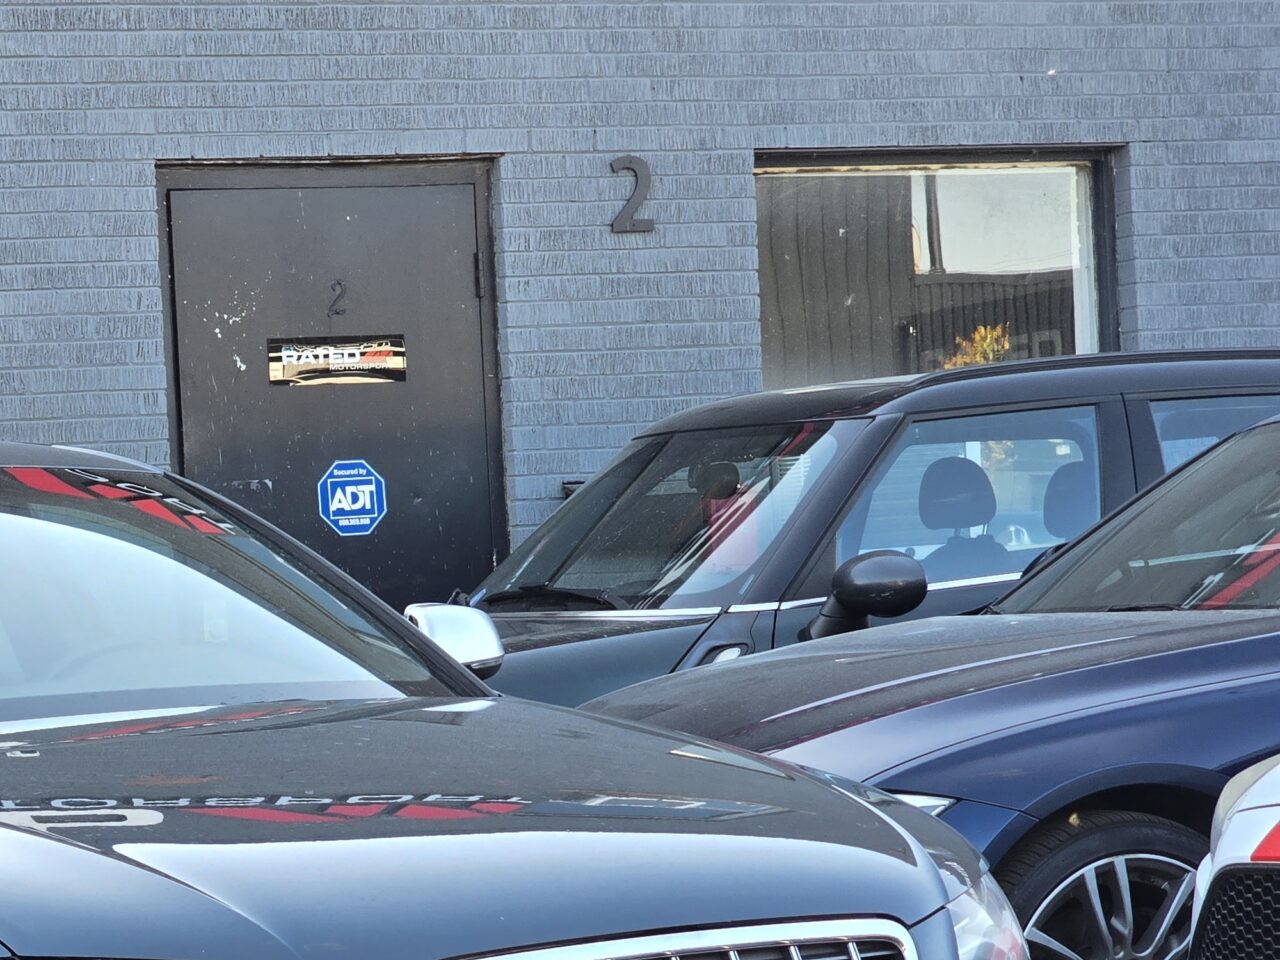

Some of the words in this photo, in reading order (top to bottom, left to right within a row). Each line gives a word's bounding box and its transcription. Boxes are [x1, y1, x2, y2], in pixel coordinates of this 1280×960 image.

[610, 155, 655, 233] 2
[327, 280, 346, 318] 2
[282, 346, 360, 365] RATED
[333, 468, 358, 476] Secured
[359, 468, 367, 476] by
[331, 485, 374, 511] ADT
